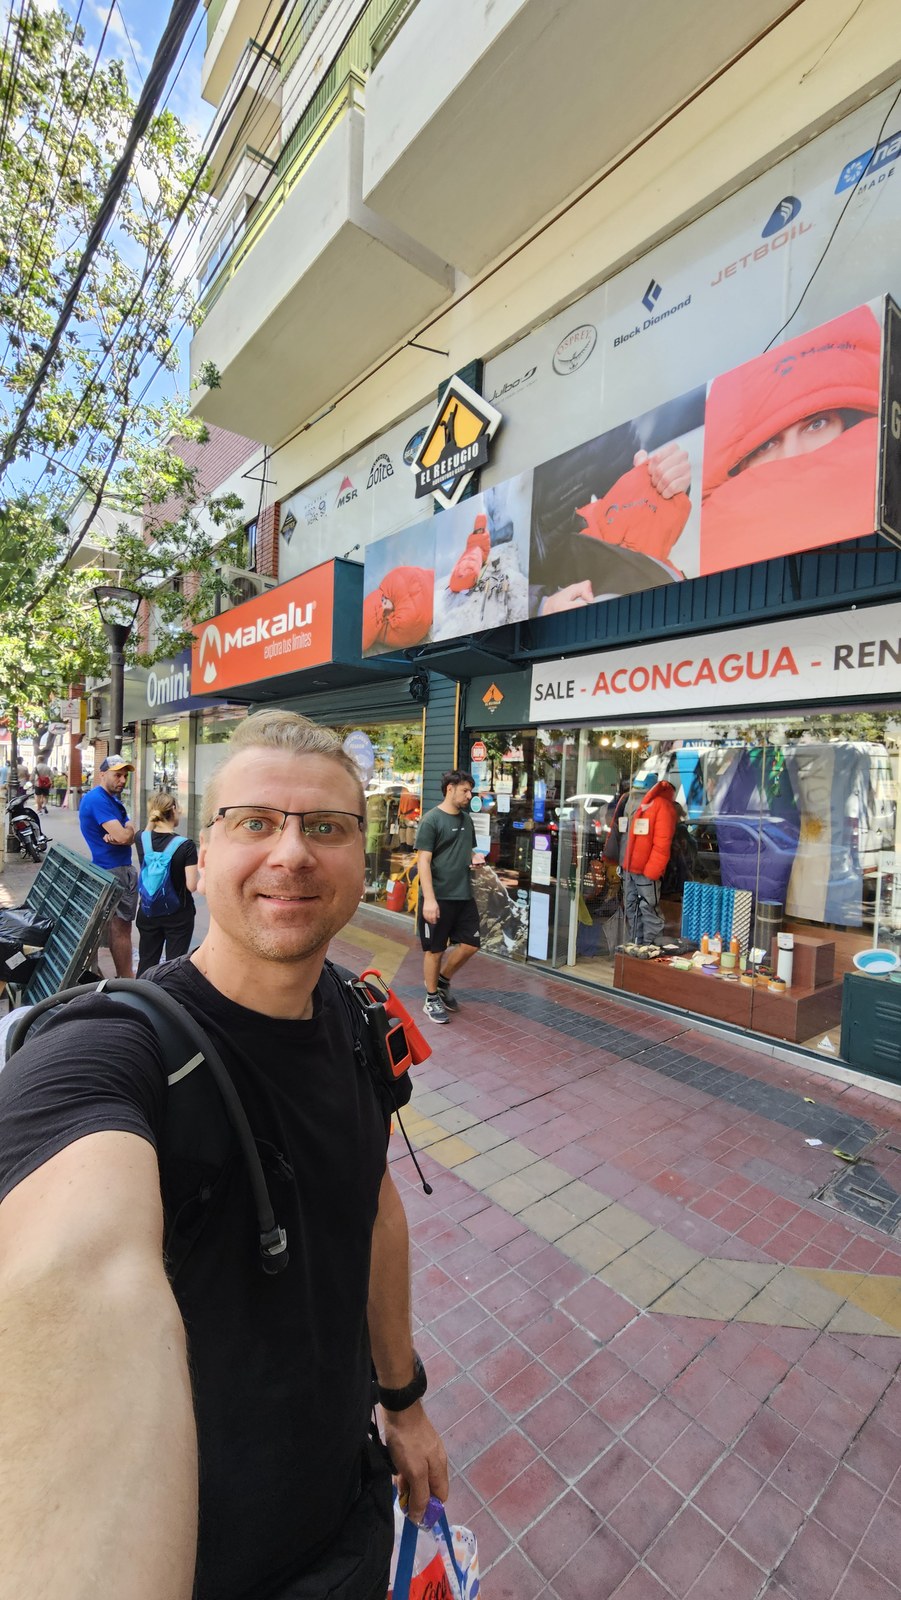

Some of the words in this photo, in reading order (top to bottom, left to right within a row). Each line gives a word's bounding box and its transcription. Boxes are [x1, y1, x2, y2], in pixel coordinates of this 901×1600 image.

[858, 167, 895, 195] MADE
[711, 221, 813, 287] JETBOIL
[613, 326, 641, 348] Black
[643, 295, 692, 331] Diamond
[421, 469, 431, 486] EL
[434, 442, 479, 479] REFUGIO
[337, 489, 359, 509] MSR
[224, 601, 313, 654] Makalu
[147, 663, 190, 708] Omint
[534, 680, 575, 701] SALE
[591, 646, 800, 697] ACONCAGUA
